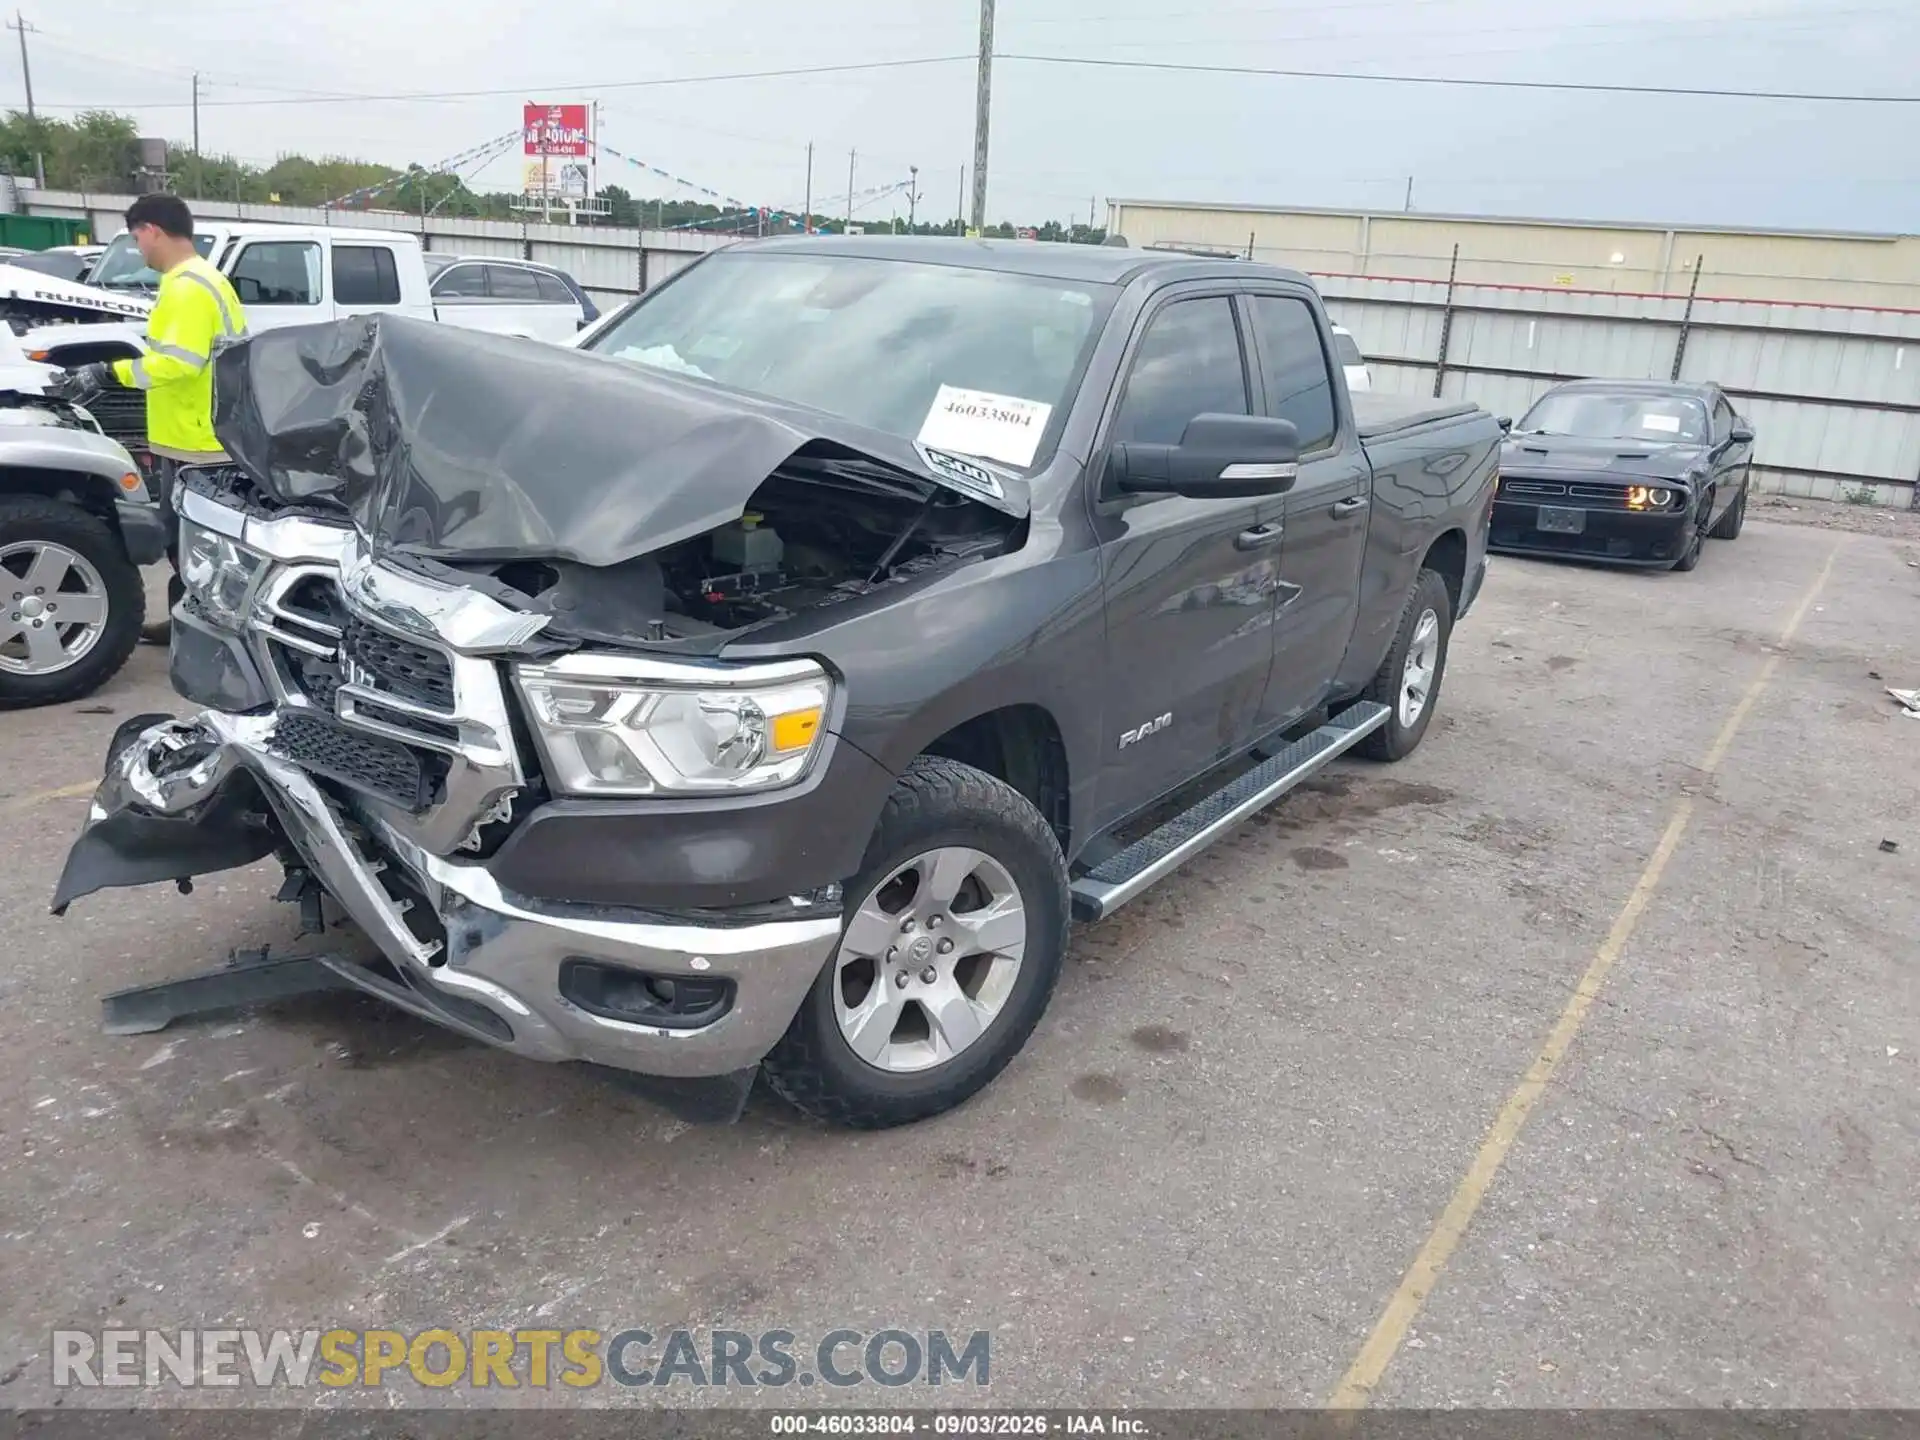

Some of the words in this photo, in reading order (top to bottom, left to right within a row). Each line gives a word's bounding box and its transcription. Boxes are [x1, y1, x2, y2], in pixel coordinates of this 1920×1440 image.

[34, 290, 152, 315] RUBICON
[944, 402, 1031, 427] 46033804
[1118, 711, 1172, 750] RAM
